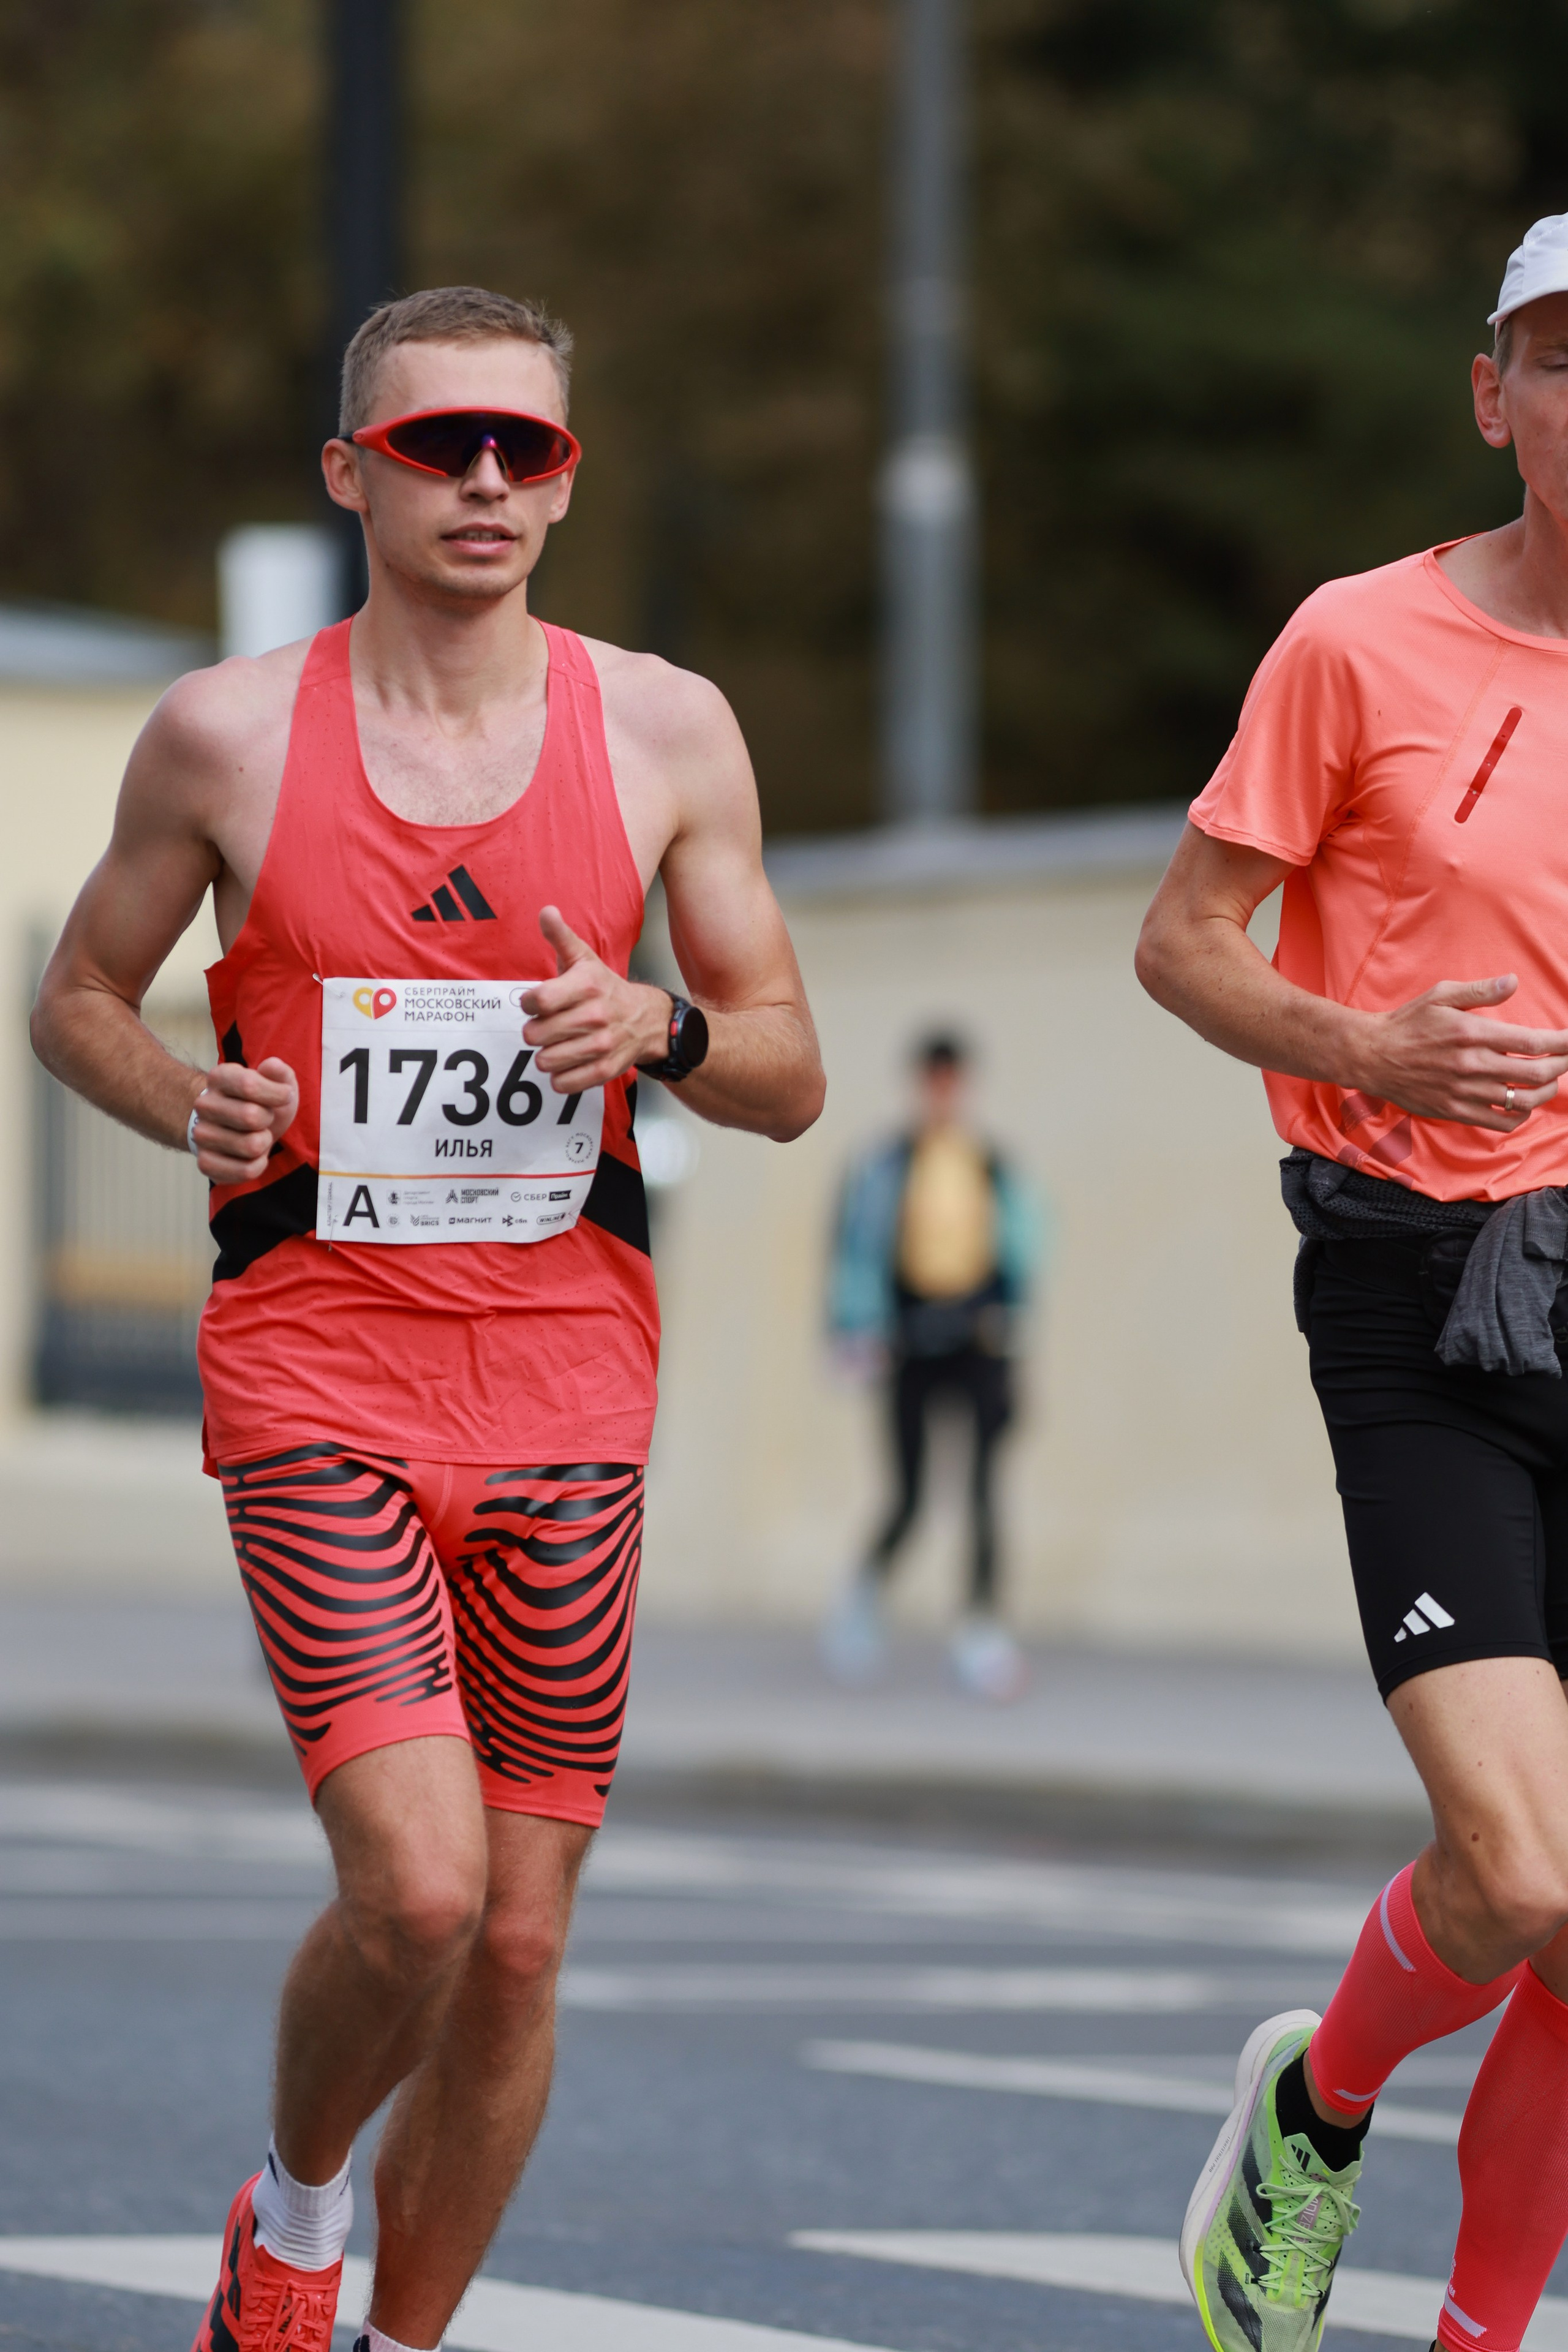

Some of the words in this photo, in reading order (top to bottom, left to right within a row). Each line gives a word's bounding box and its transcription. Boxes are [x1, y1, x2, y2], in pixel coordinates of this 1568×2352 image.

[405, 986, 475, 995] СБЕРПРАЙМ
[405, 997, 501, 1009] МОСКОВСКИЙ
[405, 1011, 475, 1022] МАРАФОН
[434, 1139, 492, 1157] ИЛЬЯ
[575, 1142, 583, 1154] 7
[461, 1188, 499, 1196] МОСКОВСКИЙ
